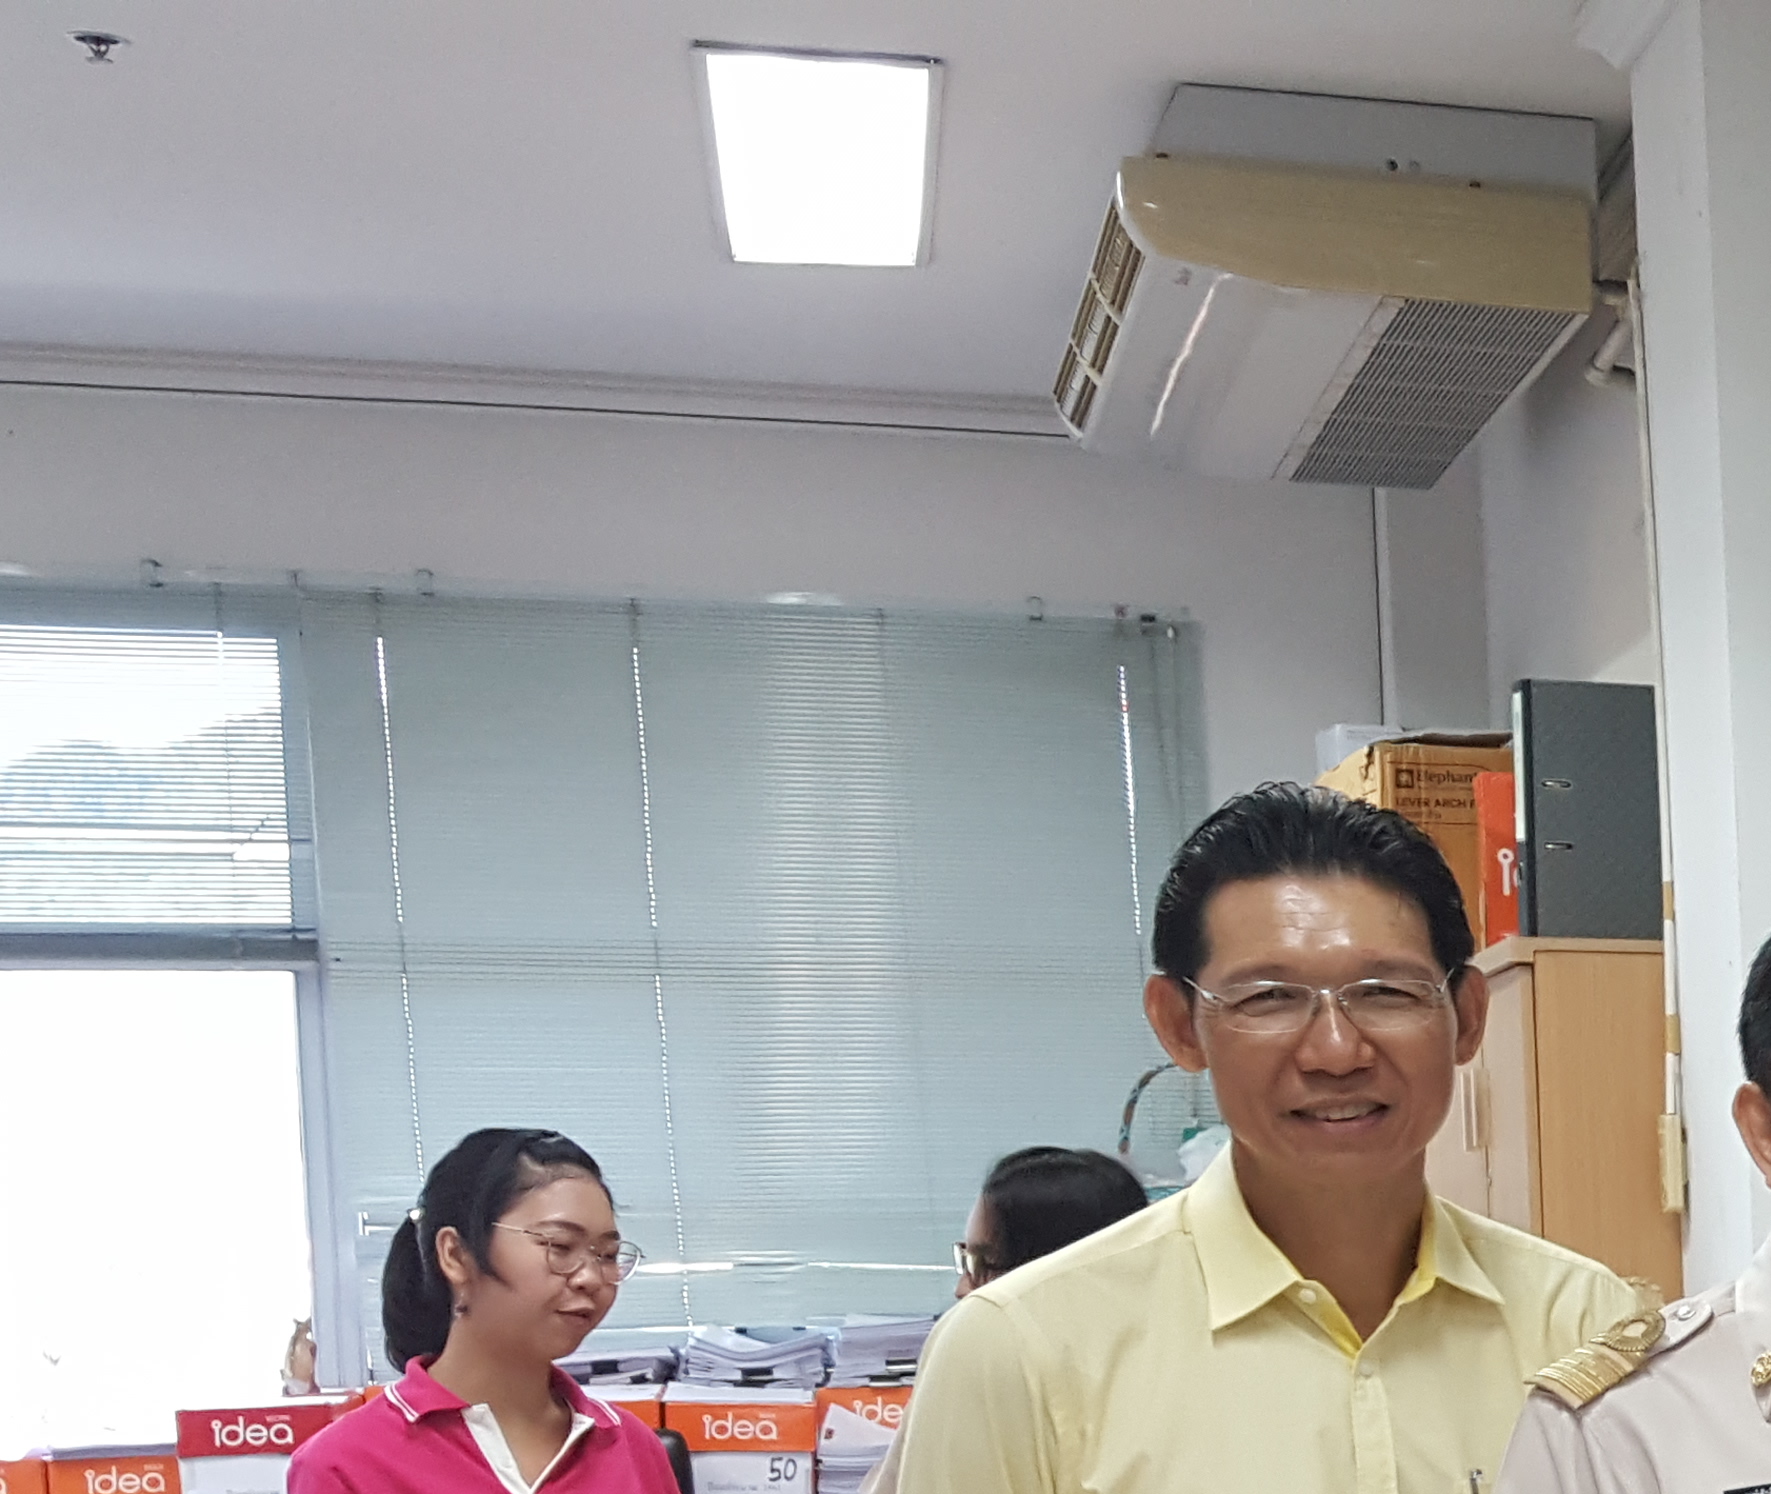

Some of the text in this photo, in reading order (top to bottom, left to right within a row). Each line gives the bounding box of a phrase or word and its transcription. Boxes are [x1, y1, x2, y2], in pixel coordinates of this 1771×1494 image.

[211, 1415, 294, 1448] idea
[702, 1412, 778, 1440] idea
[768, 1457, 798, 1483] 50
